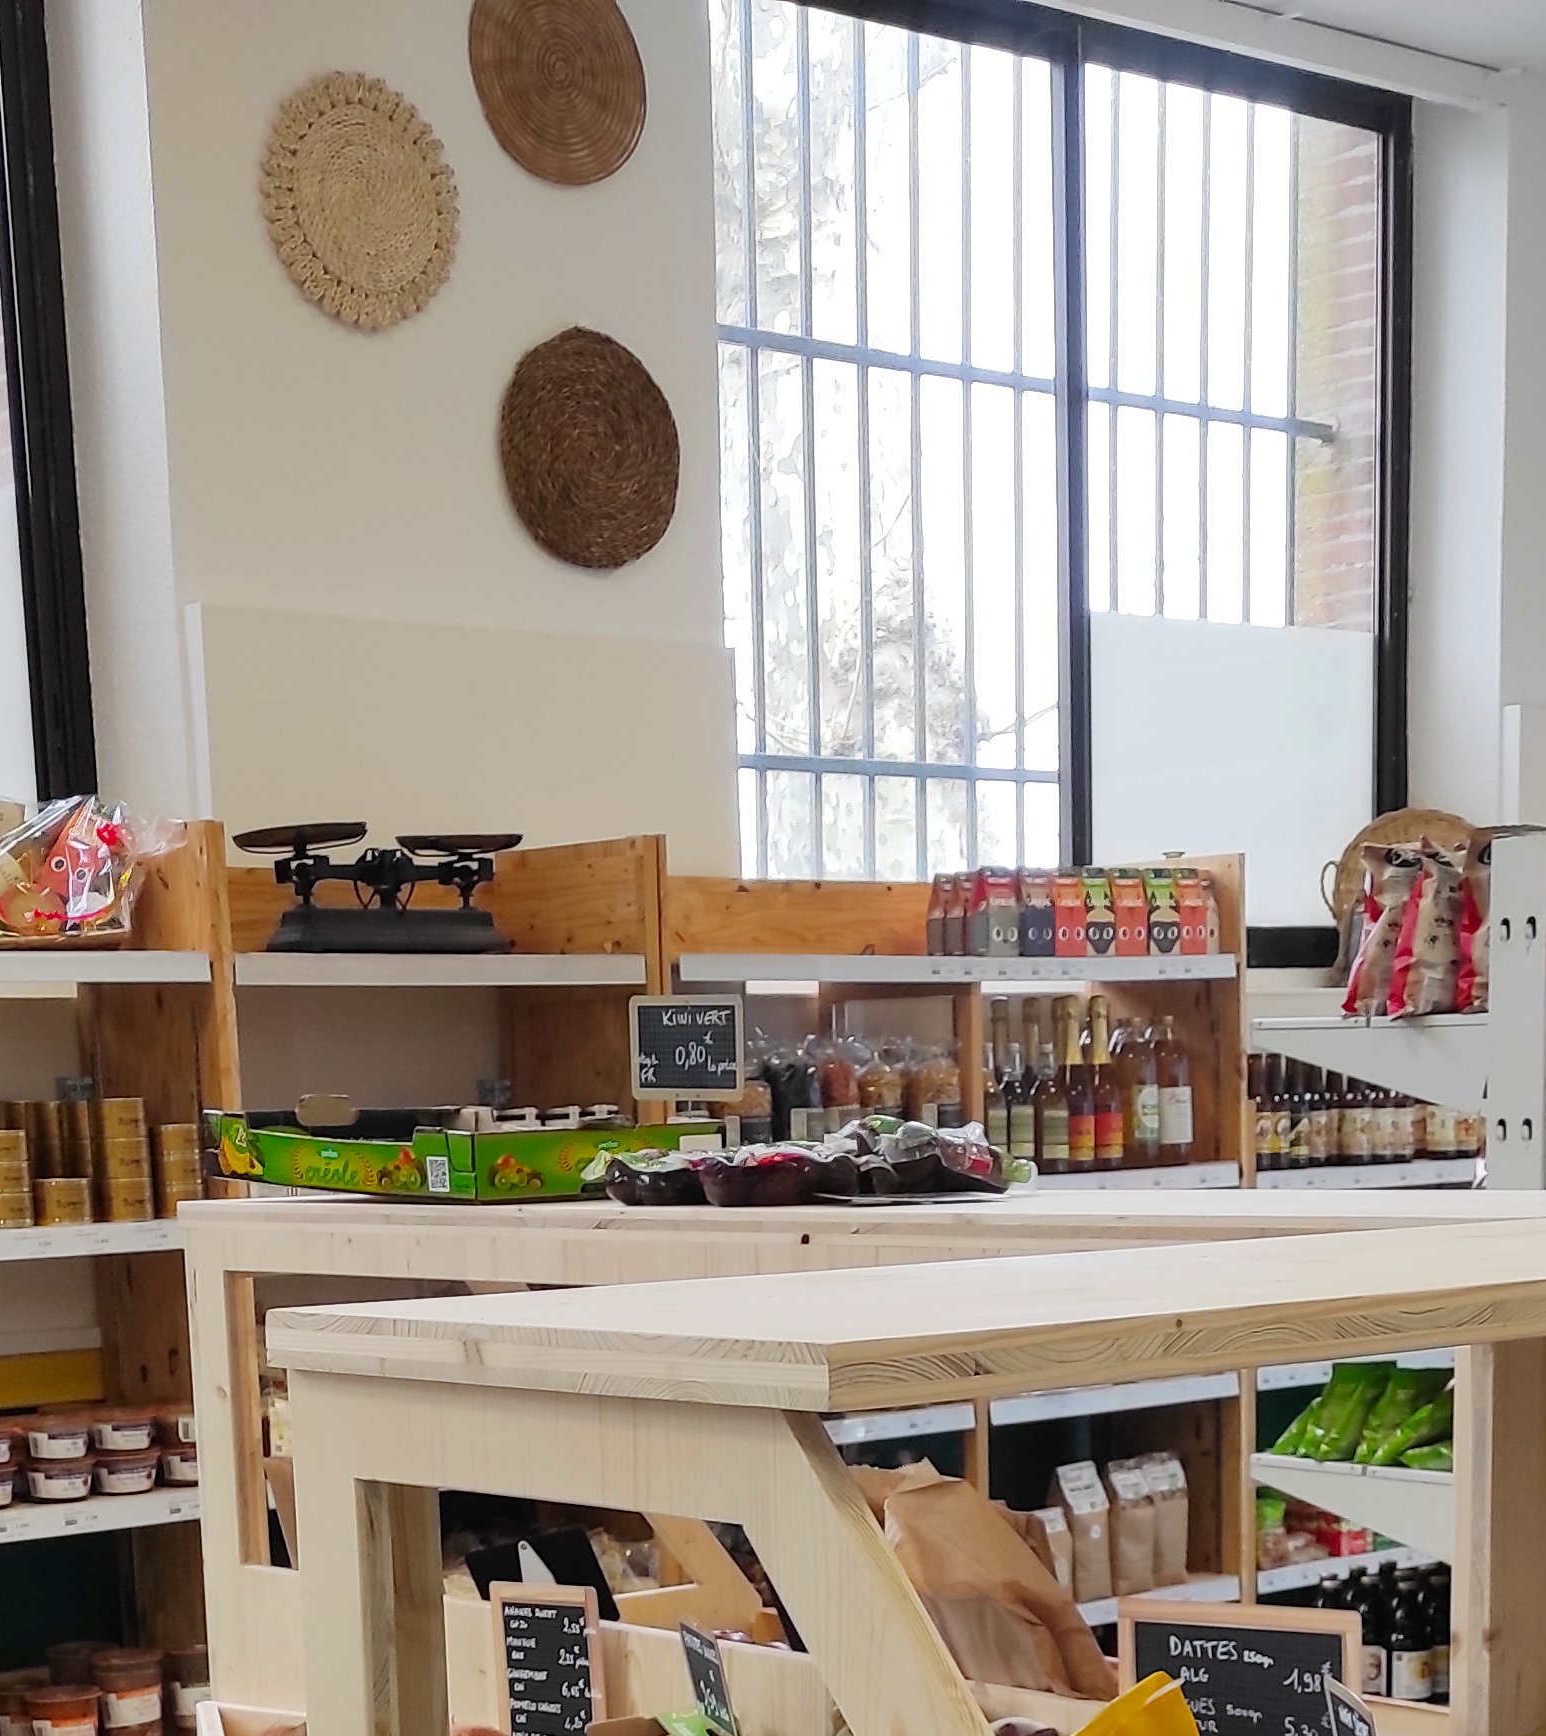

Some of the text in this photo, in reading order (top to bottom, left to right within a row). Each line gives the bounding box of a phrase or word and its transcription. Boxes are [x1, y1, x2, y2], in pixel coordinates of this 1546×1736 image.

[696, 1009, 731, 1026] VERT
[675, 1041, 706, 1070] 0,80
[1169, 1634, 1238, 1661] DATTES
[1179, 1666, 1210, 1683] ALG
[1282, 1667, 1322, 1694] 1,98
